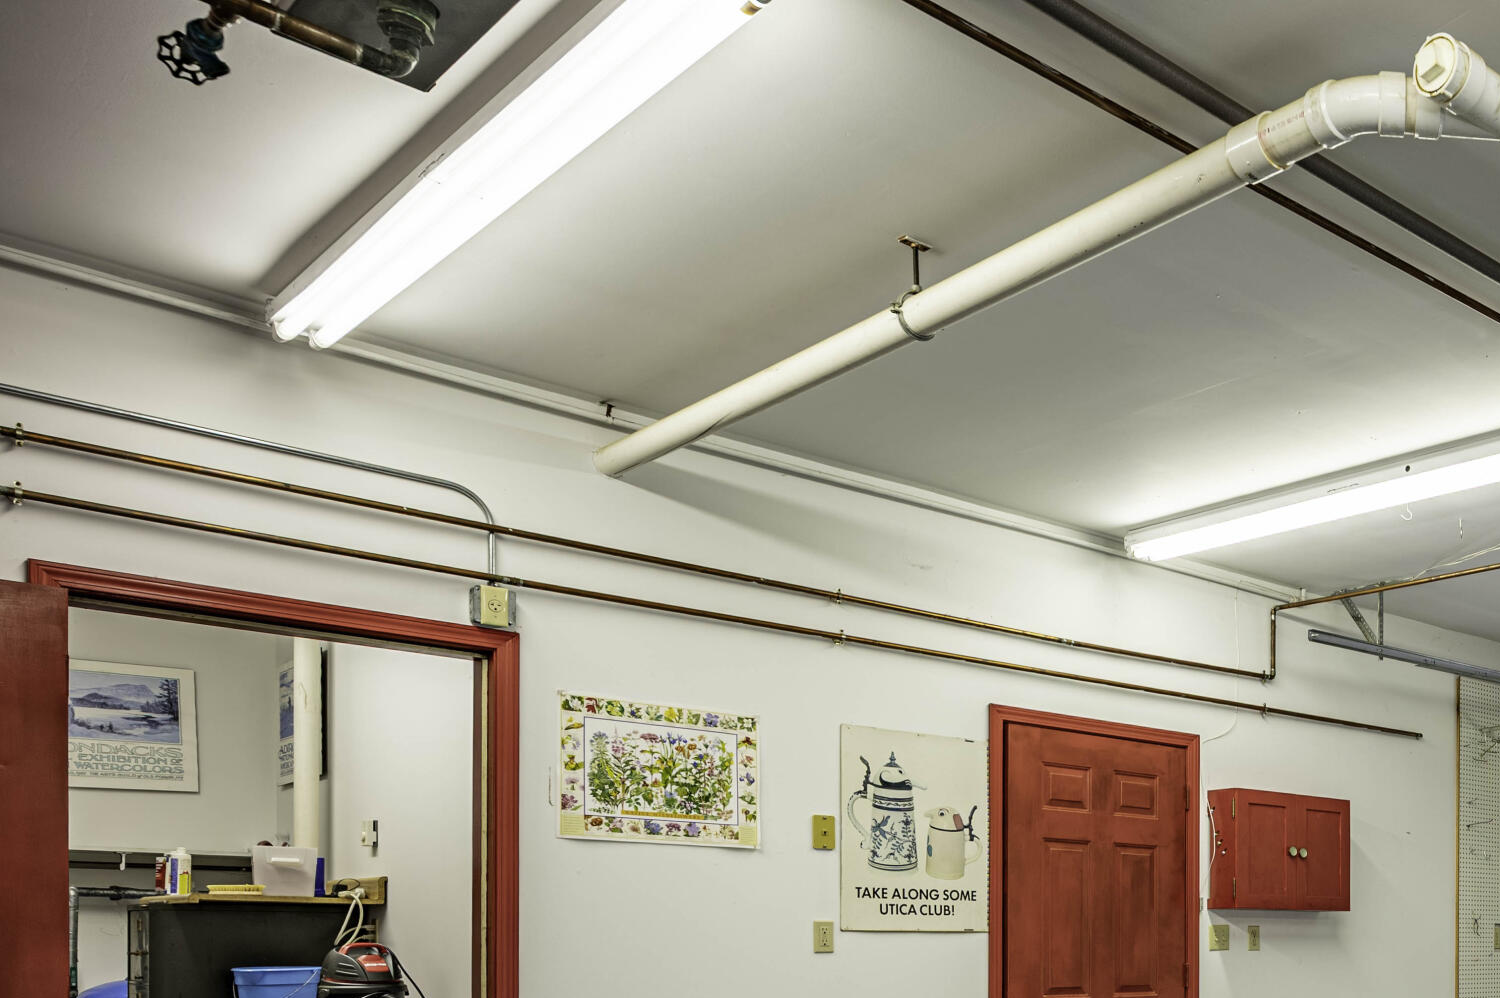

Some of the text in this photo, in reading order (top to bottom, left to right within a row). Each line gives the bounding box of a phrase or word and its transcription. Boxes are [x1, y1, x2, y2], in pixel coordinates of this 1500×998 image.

[78, 753, 167, 765] EXHIBITION
[73, 761, 184, 774] WATERCOLORS
[855, 887, 977, 901] TAKE ALONG SOME
[879, 903, 955, 916] UTICA CLUB!
